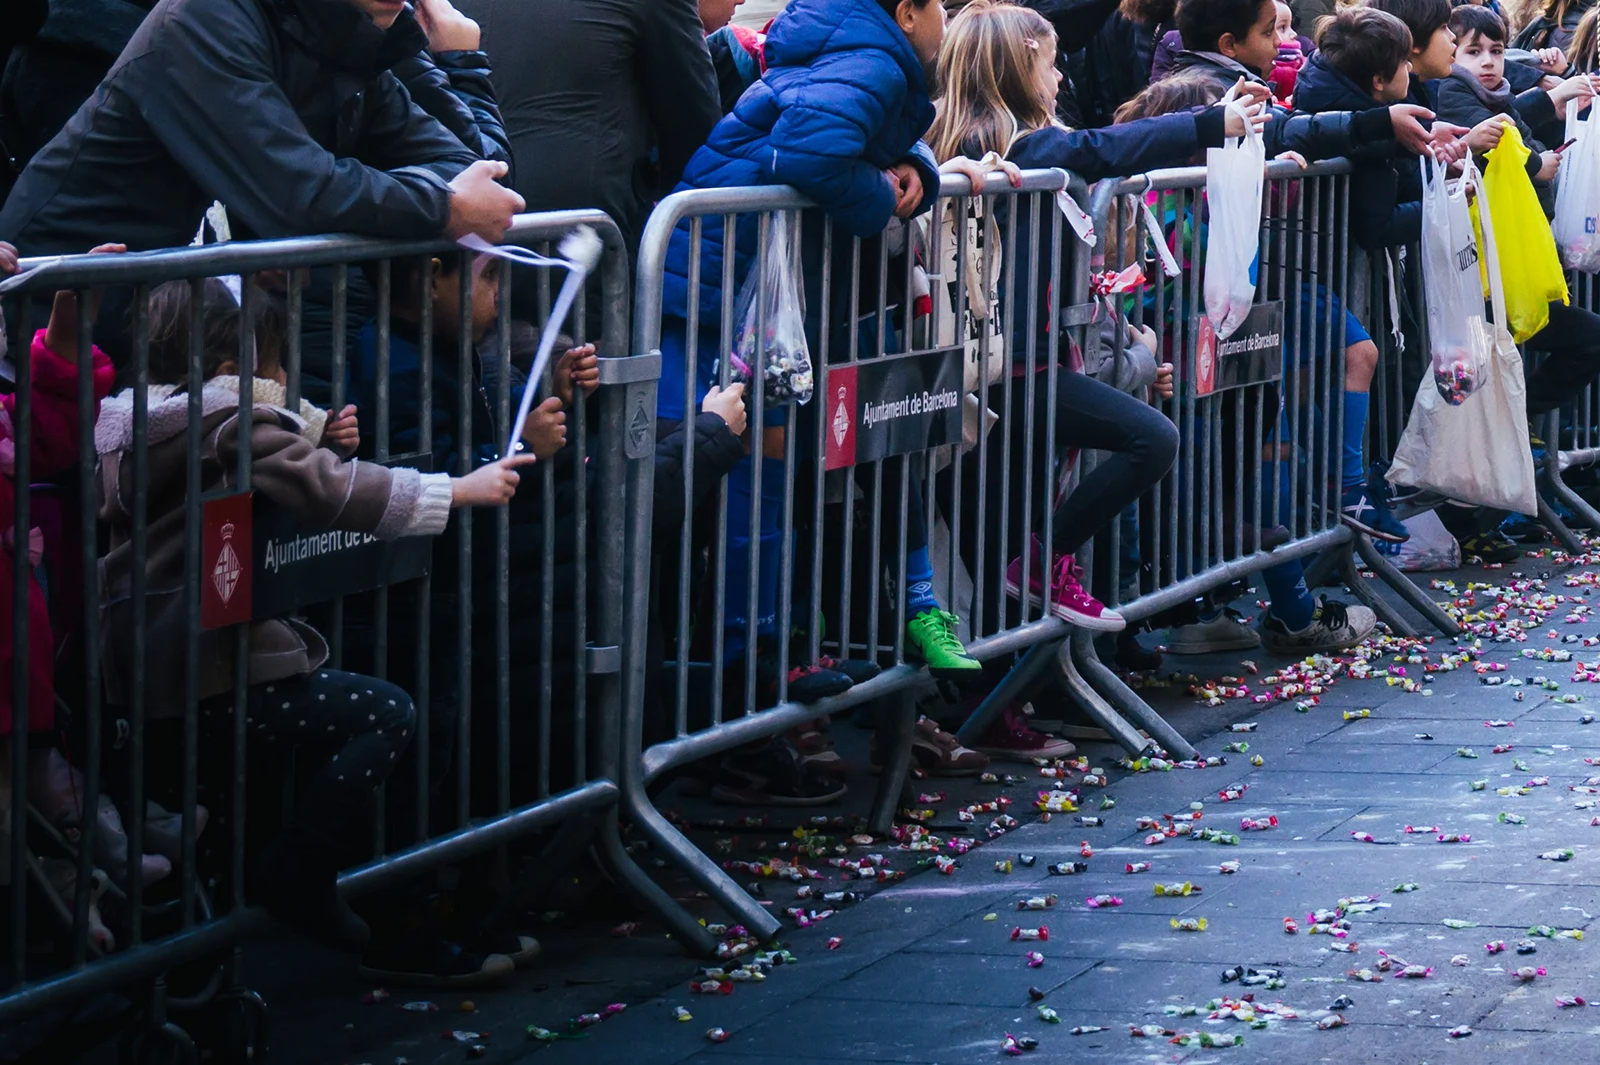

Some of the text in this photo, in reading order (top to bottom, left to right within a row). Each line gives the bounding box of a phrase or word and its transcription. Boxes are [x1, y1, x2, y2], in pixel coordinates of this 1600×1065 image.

[1254, 330, 1280, 350] Barcelona
[863, 390, 958, 428] Ajuntament de Barcelona
[264, 529, 342, 574] Ajuntament
